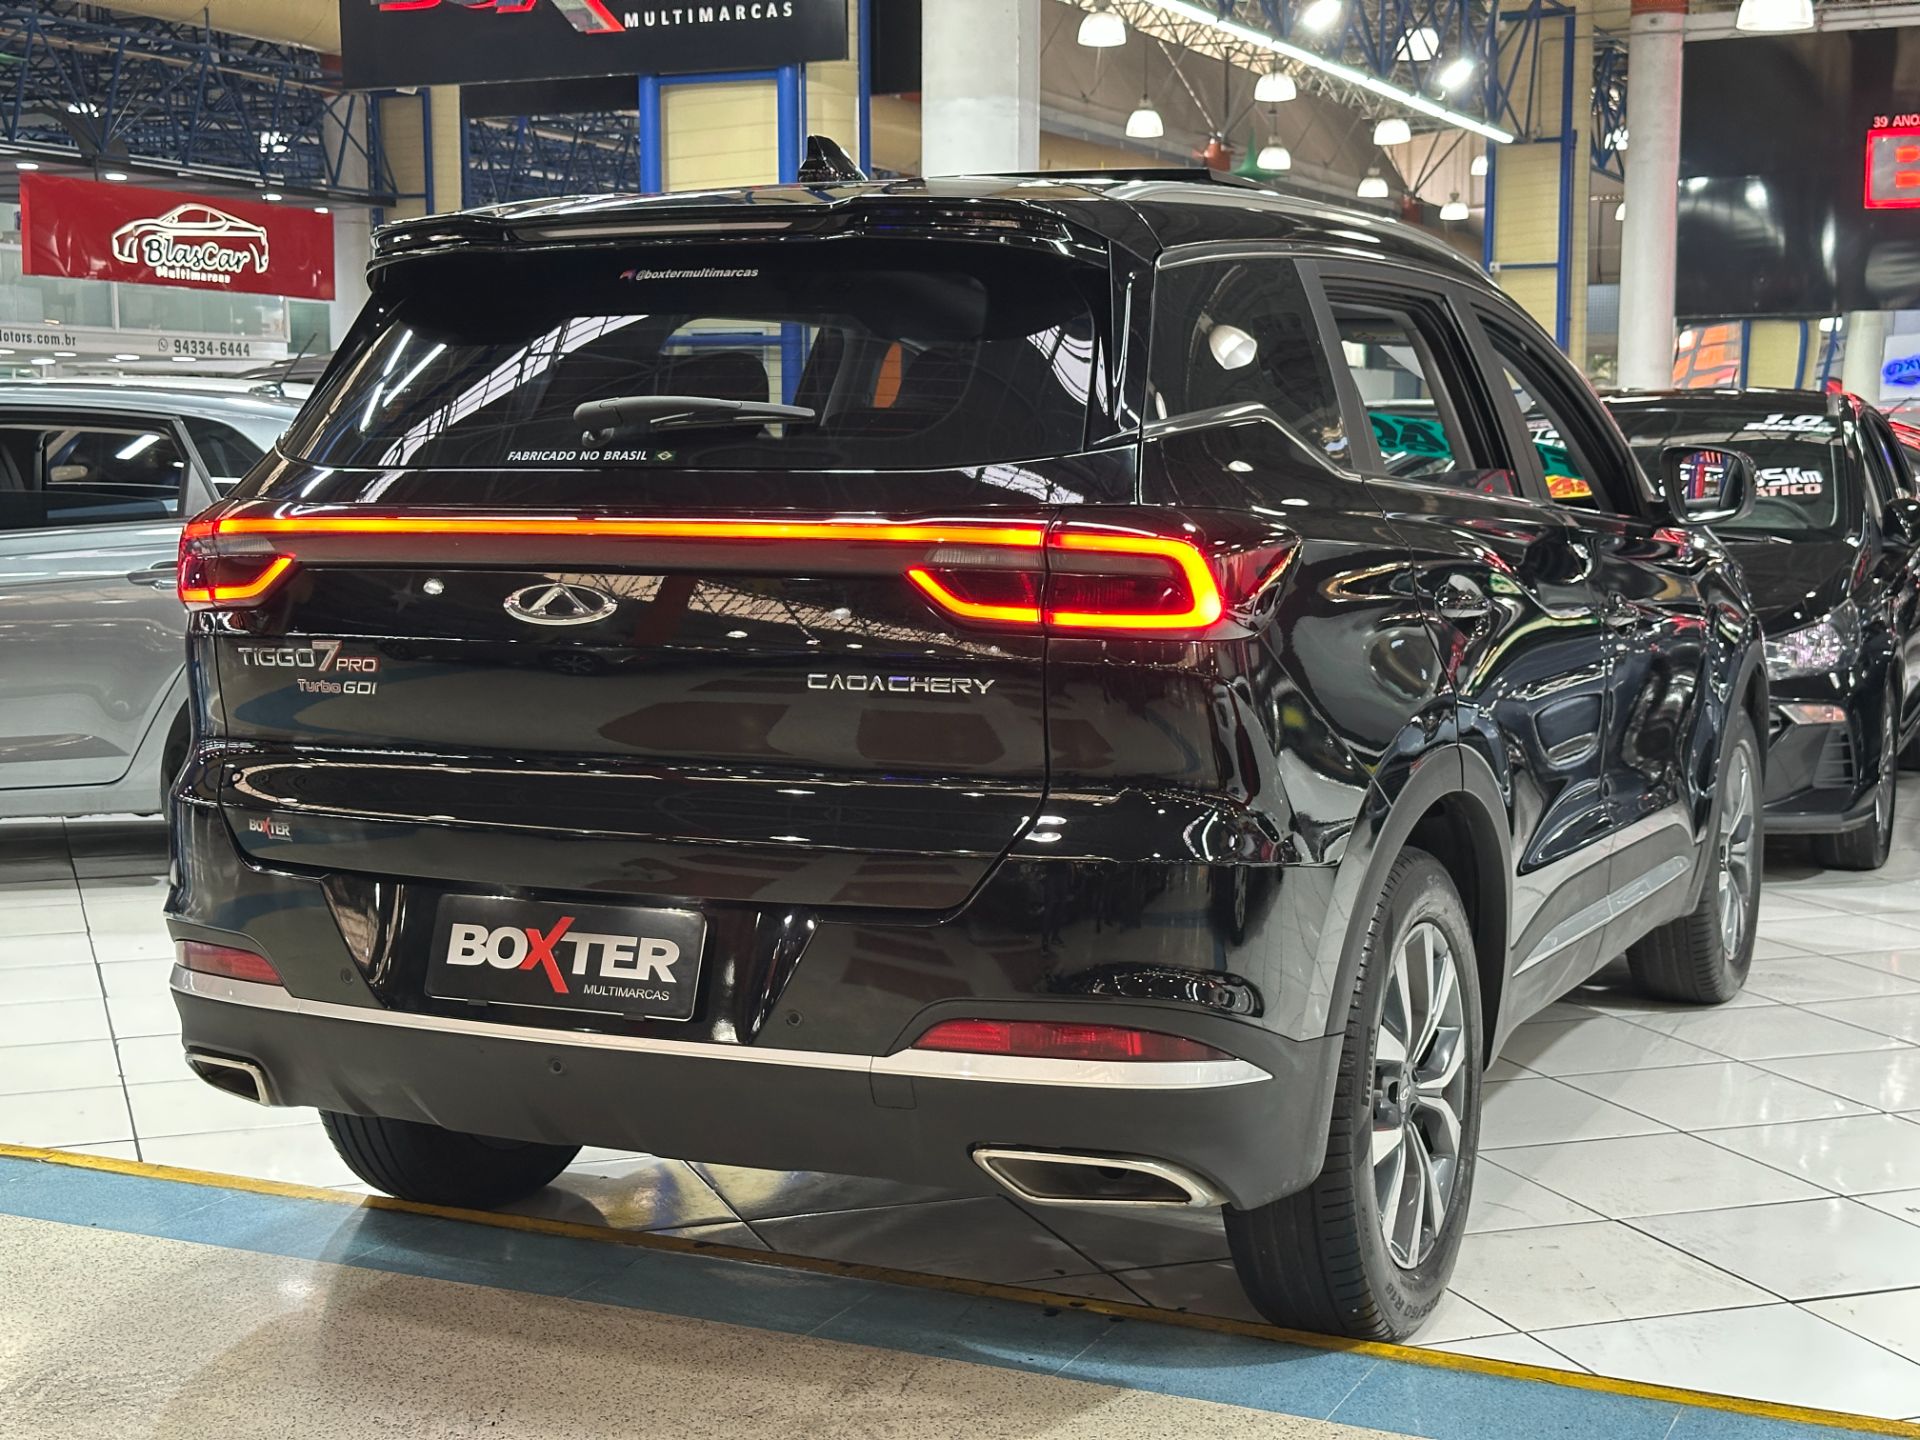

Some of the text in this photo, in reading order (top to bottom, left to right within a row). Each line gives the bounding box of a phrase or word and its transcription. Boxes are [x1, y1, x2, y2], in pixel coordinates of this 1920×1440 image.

[625, 1, 793, 28] MULTIMARCAS
[1873, 114, 1920, 128] 39 ANO
[143, 236, 250, 272] BlasCar
[636, 267, 759, 281] @boxtermultimarcas
[174, 339, 251, 357] 94334-6444
[507, 450, 647, 462] FABRICADO NO BRASIL
[311, 639, 343, 672] 7
[335, 656, 380, 672] PRO
[297, 678, 378, 695] Turbo GDI
[249, 817, 291, 839] BOXTER
[446, 916, 681, 994] BOXTER
[583, 984, 671, 1001] MULTIMARCAS
